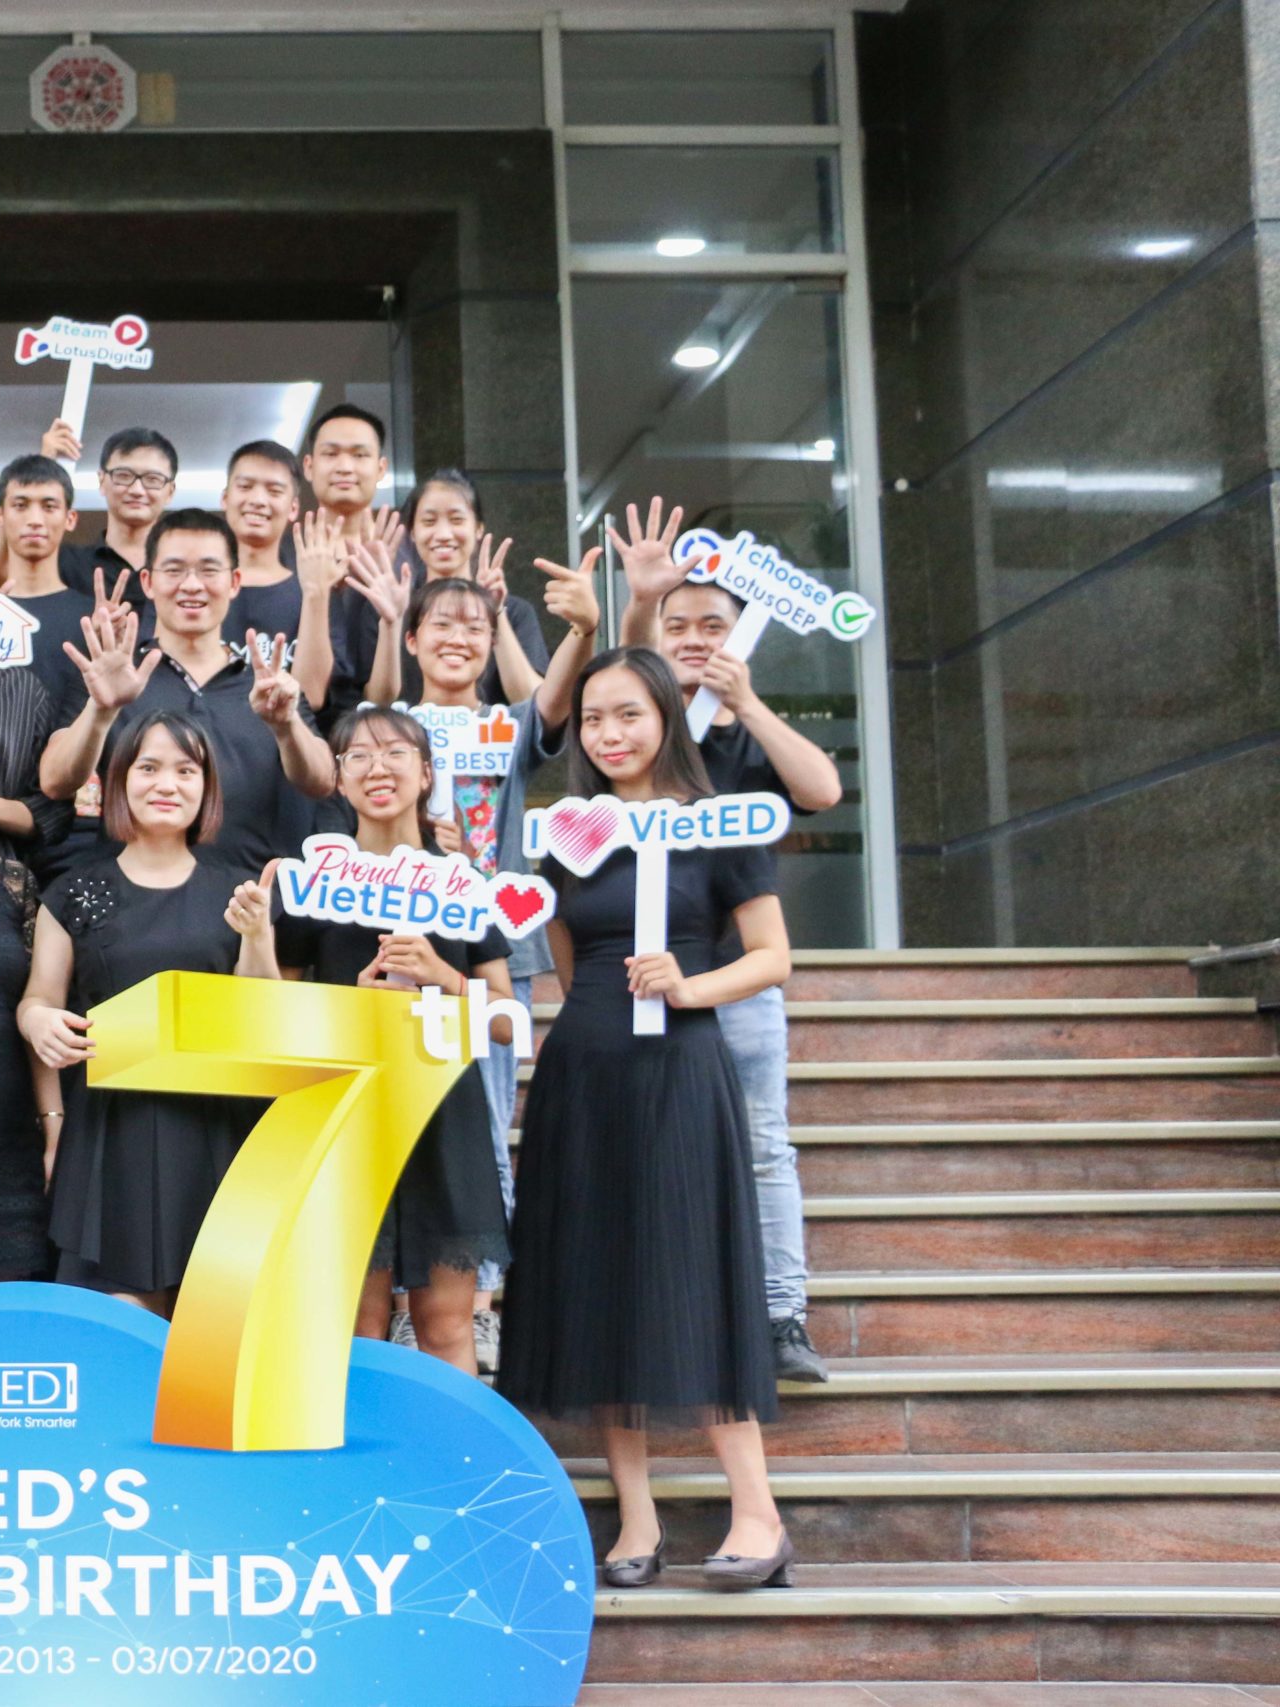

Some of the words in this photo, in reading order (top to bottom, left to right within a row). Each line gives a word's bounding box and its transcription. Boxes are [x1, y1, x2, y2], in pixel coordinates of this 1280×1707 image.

[51, 322, 108, 340] #team
[54, 343, 149, 365] LotusDigital
[736, 538, 748, 556] I
[748, 551, 828, 606] choose
[724, 565, 817, 629] LotusOEP
[414, 709, 469, 727] otus
[454, 752, 510, 770] BEST
[530, 818, 539, 849] I
[628, 803, 776, 842] VietED
[308, 844, 407, 888] Proud
[408, 862, 437, 896] to
[446, 864, 479, 897] be
[288, 869, 488, 931] VietEDer
[1, 1370, 61, 1405] ED
[25, 1416, 77, 1428] Smarter
[111, 1645, 317, 1676] 03/07/2020
